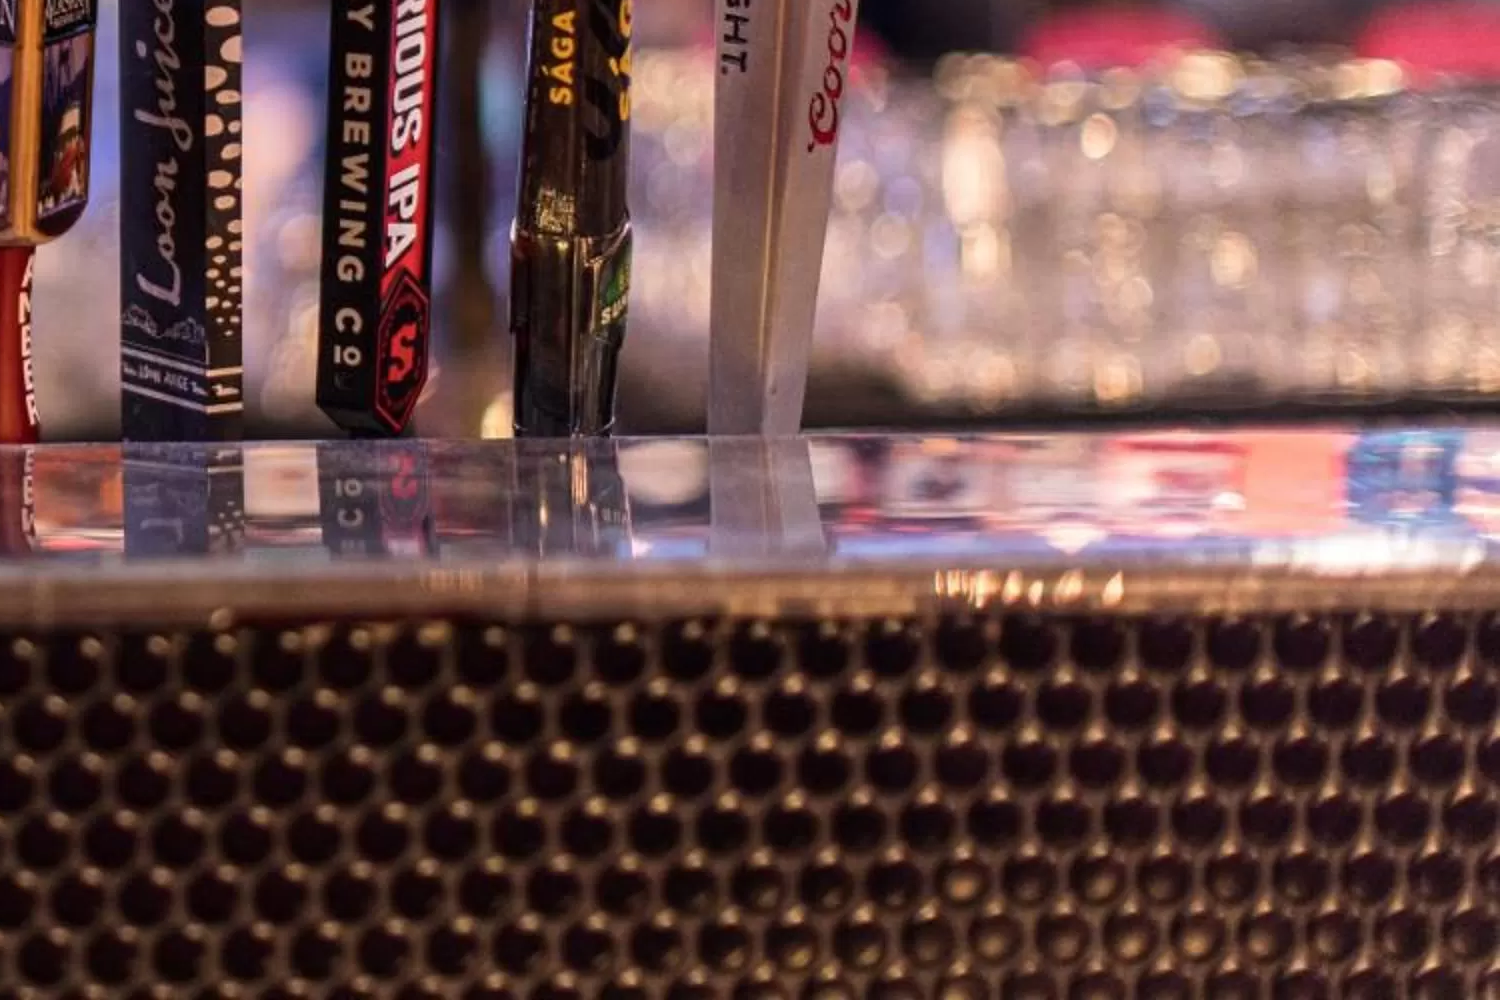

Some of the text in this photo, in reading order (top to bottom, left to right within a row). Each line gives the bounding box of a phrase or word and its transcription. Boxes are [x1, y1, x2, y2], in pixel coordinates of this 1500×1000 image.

[137, 156, 181, 306] Loon
[336, 51, 373, 282] BREWING
[385, 163, 421, 269] IPA
